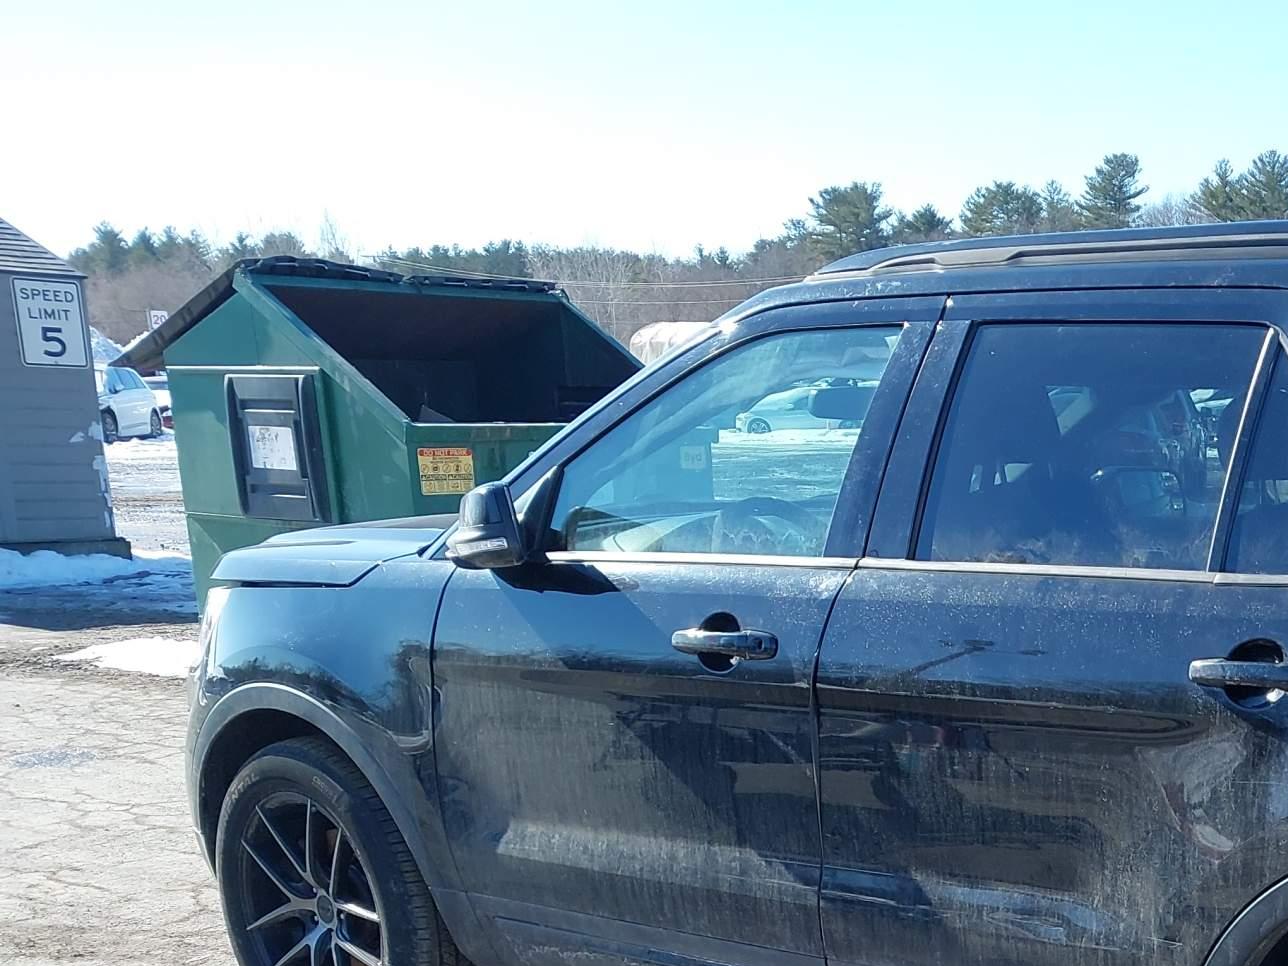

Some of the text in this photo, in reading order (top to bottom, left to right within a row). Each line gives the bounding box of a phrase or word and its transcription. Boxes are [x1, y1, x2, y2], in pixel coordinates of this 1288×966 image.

[19, 287, 75, 303] SPEED
[27, 307, 71, 321] LIMIT
[40, 326, 67, 358] 5
